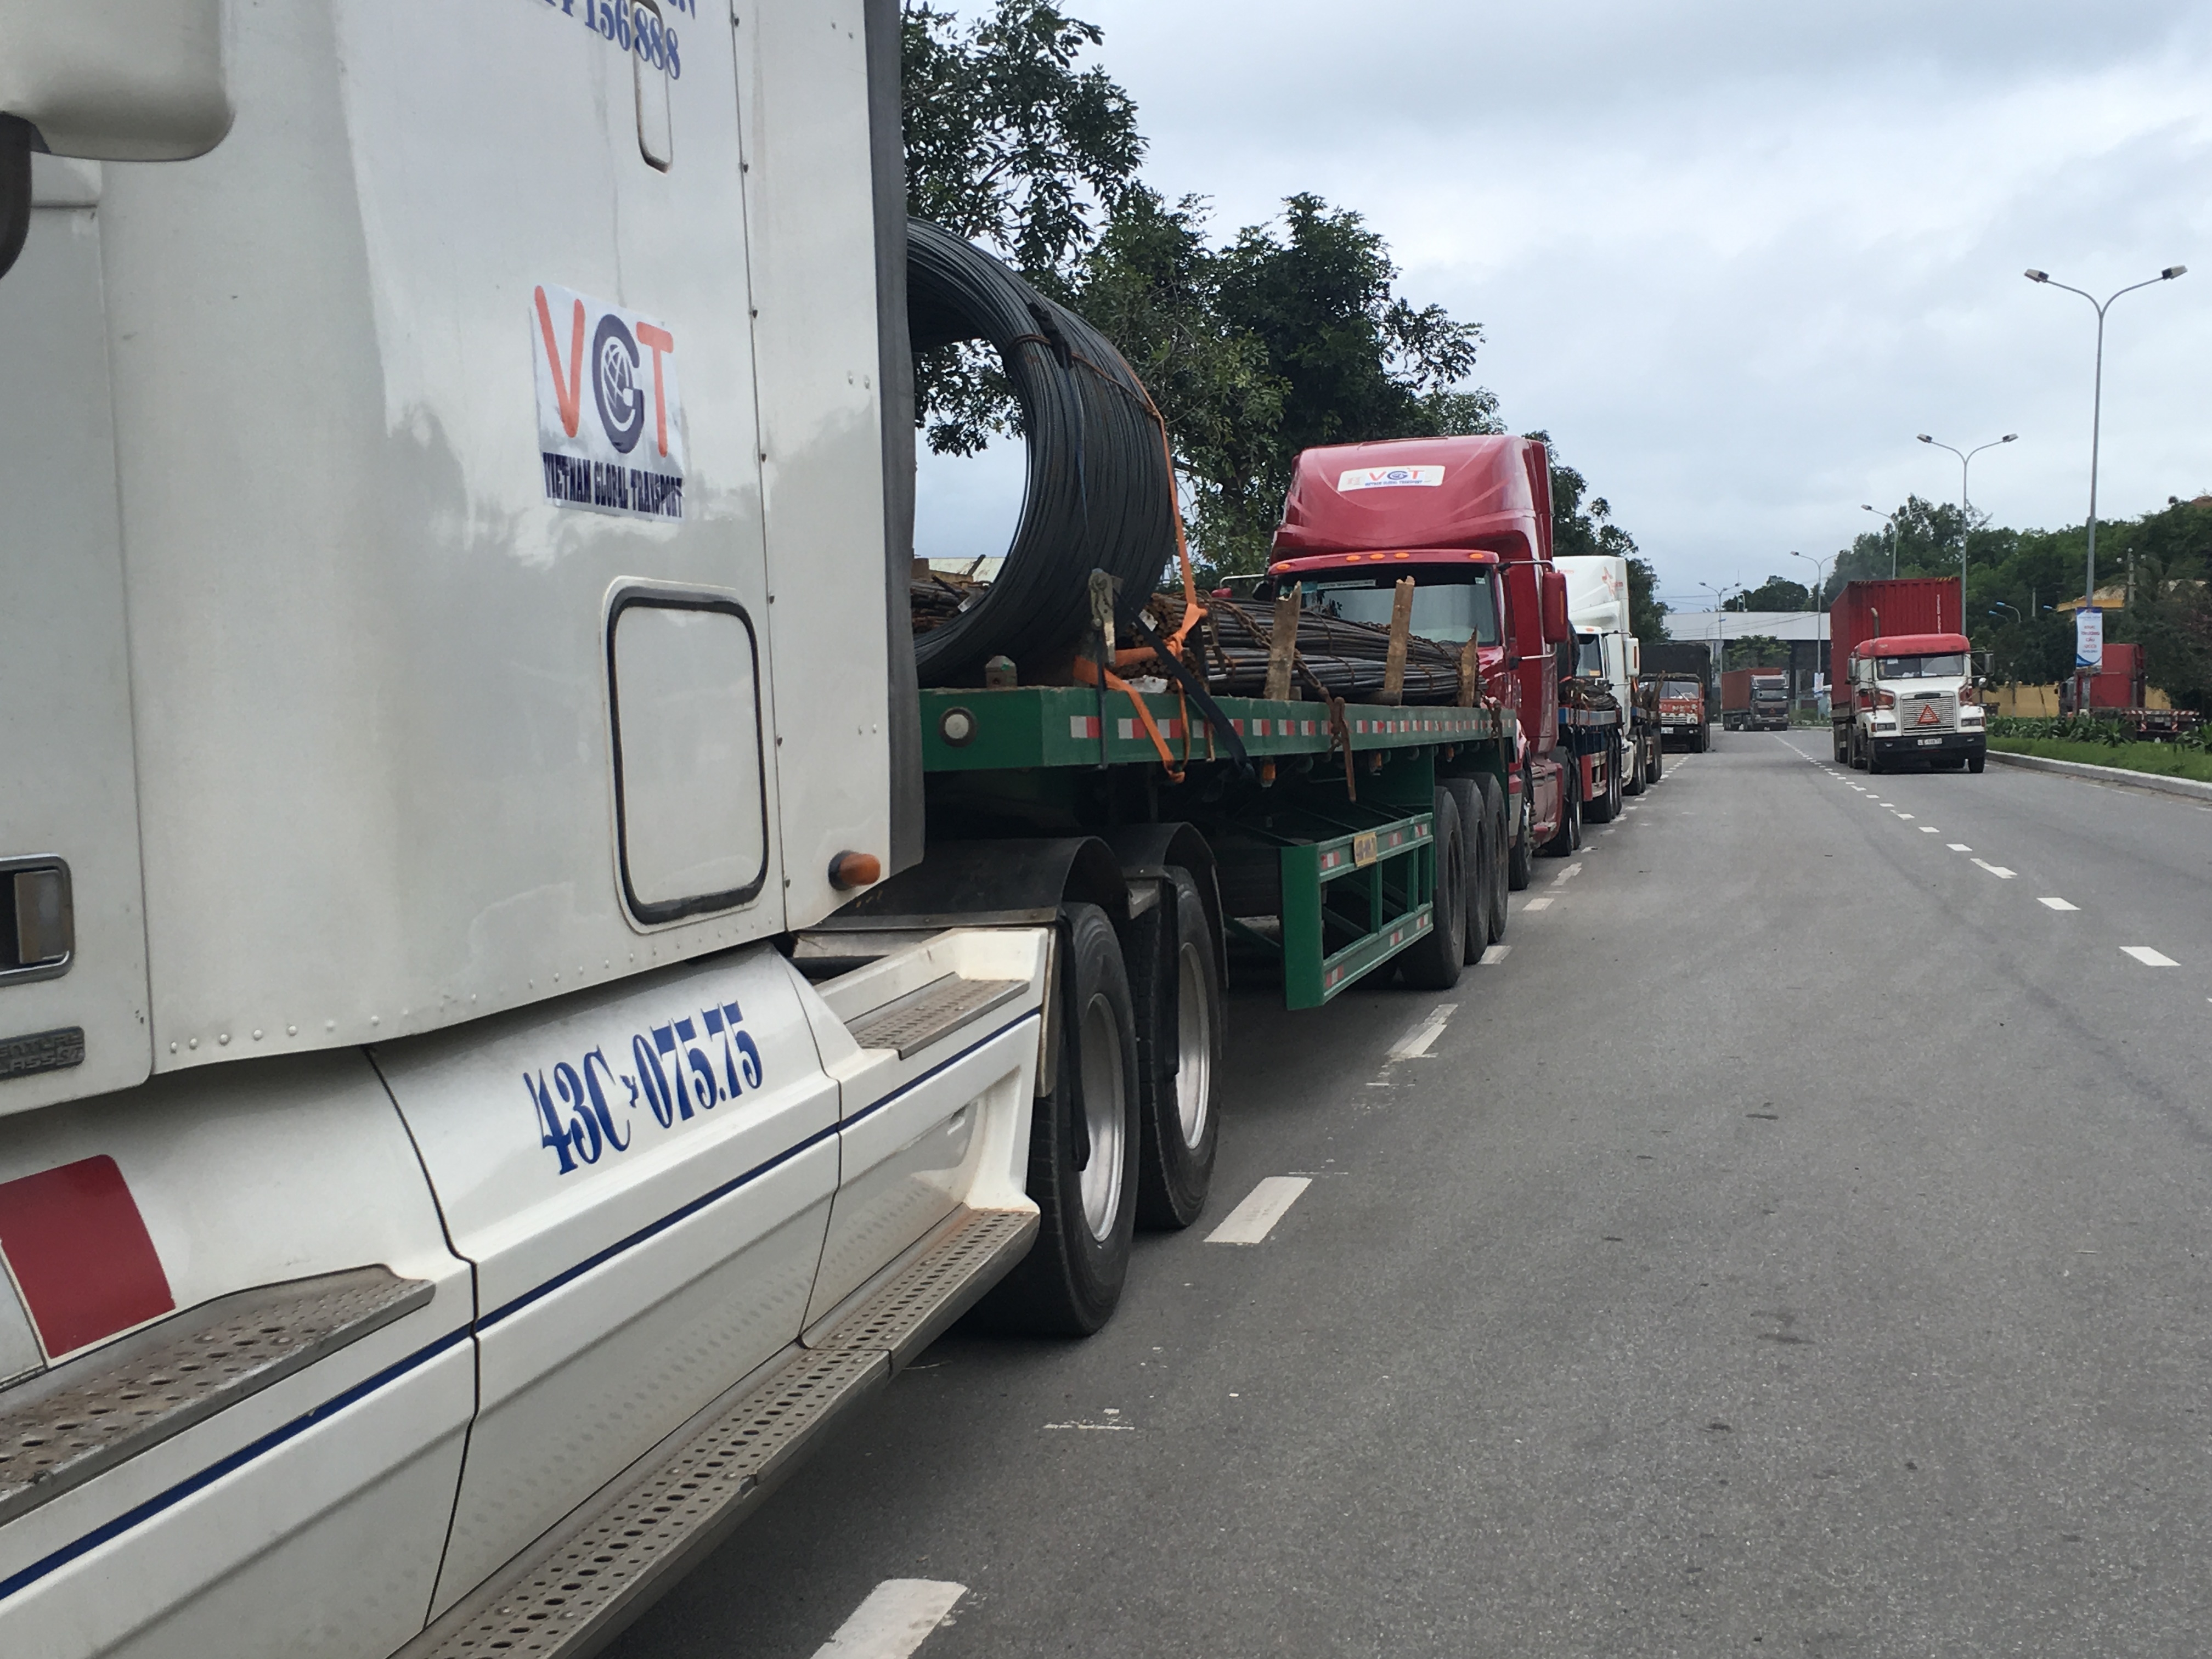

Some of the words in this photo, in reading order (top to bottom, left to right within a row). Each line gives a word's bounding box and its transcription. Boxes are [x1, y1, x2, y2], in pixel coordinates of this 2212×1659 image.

[534, 285, 674, 458] VGT
[543, 452, 592, 504] VIETNAM
[594, 460, 629, 510] GLOBAL
[1369, 470, 1425, 481] VGT
